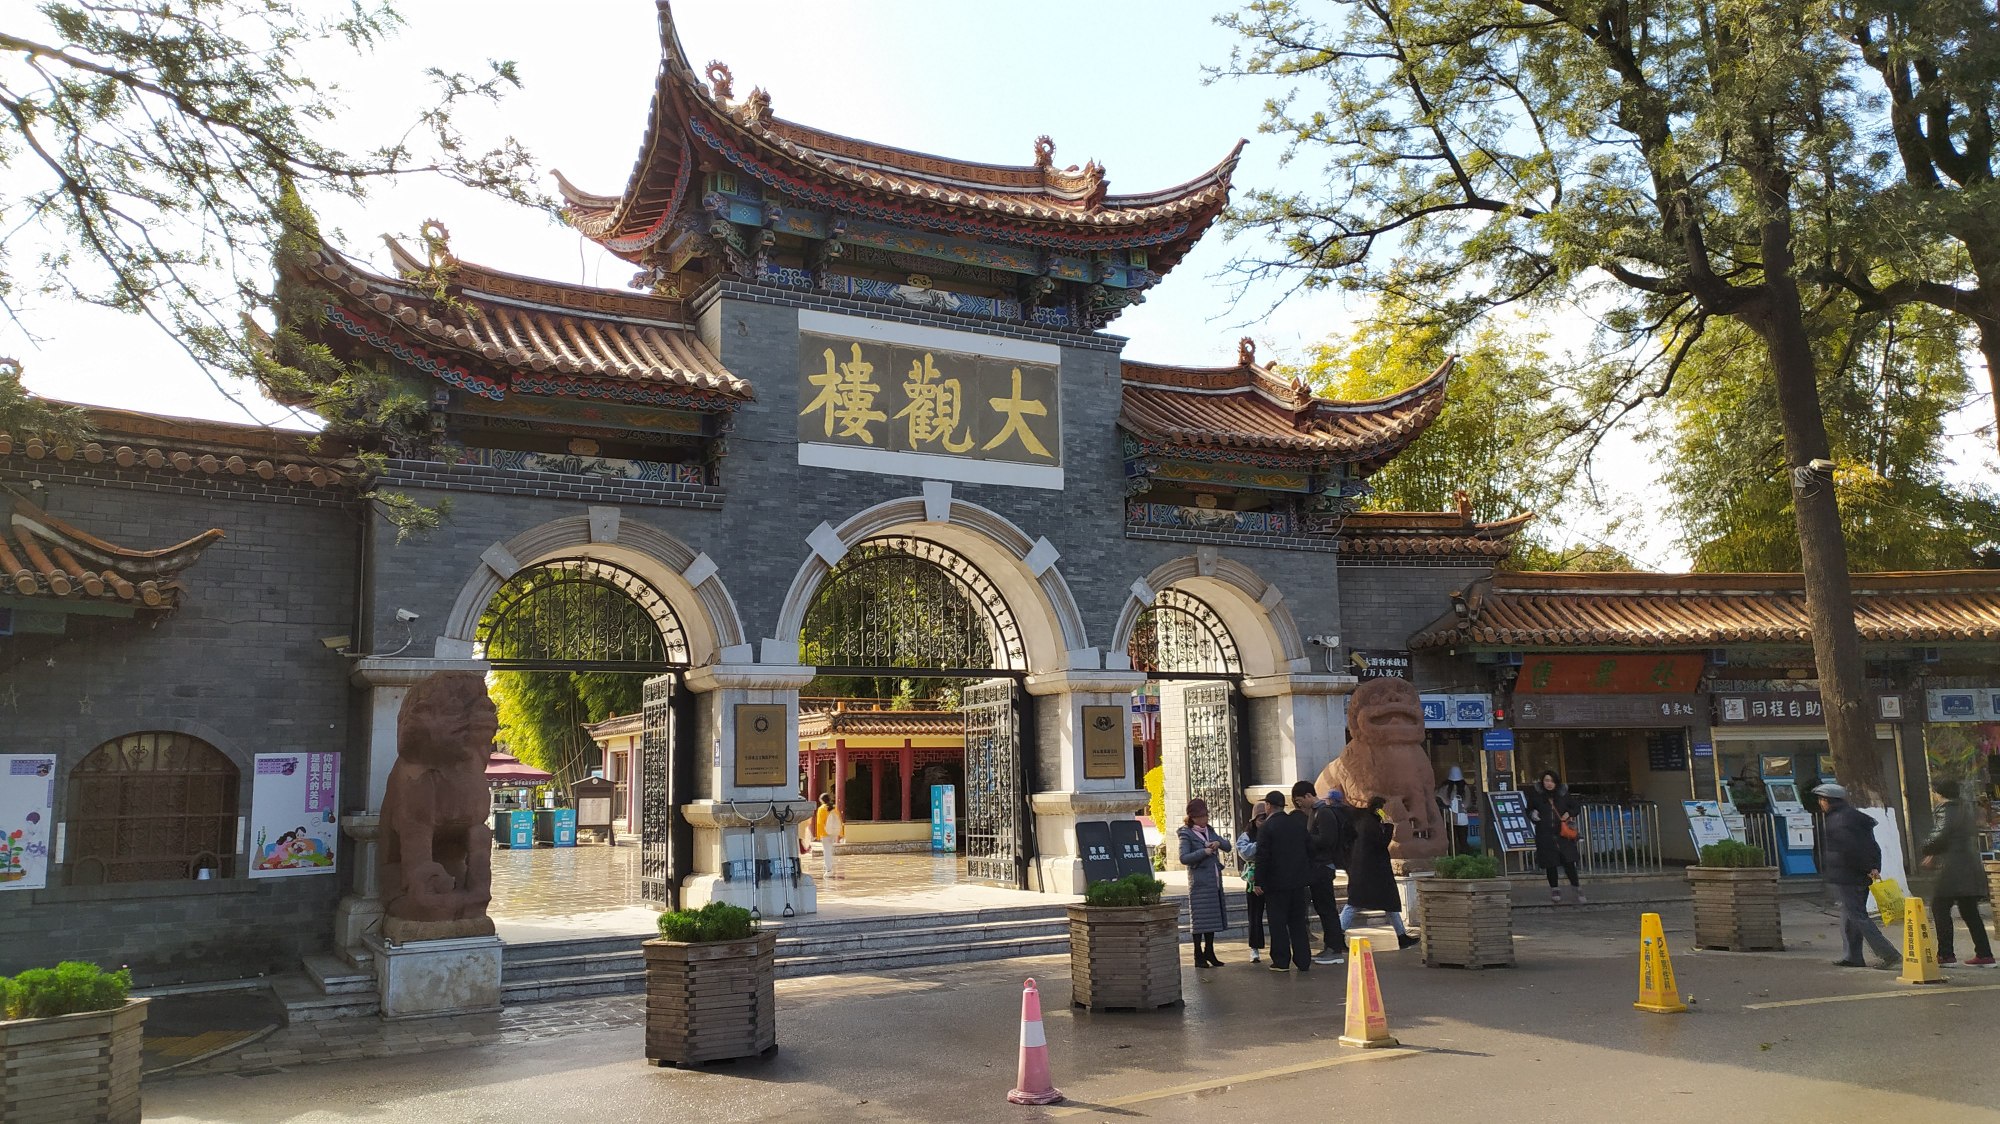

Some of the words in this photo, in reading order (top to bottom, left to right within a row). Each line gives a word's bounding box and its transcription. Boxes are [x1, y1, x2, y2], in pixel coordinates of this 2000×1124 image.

[1364, 657, 1408, 667] 大游客承载量
[1361, 668, 1403, 678] 7万人次/天
[1661, 703, 1694, 715] 售票处
[1752, 701, 1820, 717] 同程自助
[322, 753, 334, 791] 你的陪伴
[309, 754, 320, 809] 是最大的关爱
